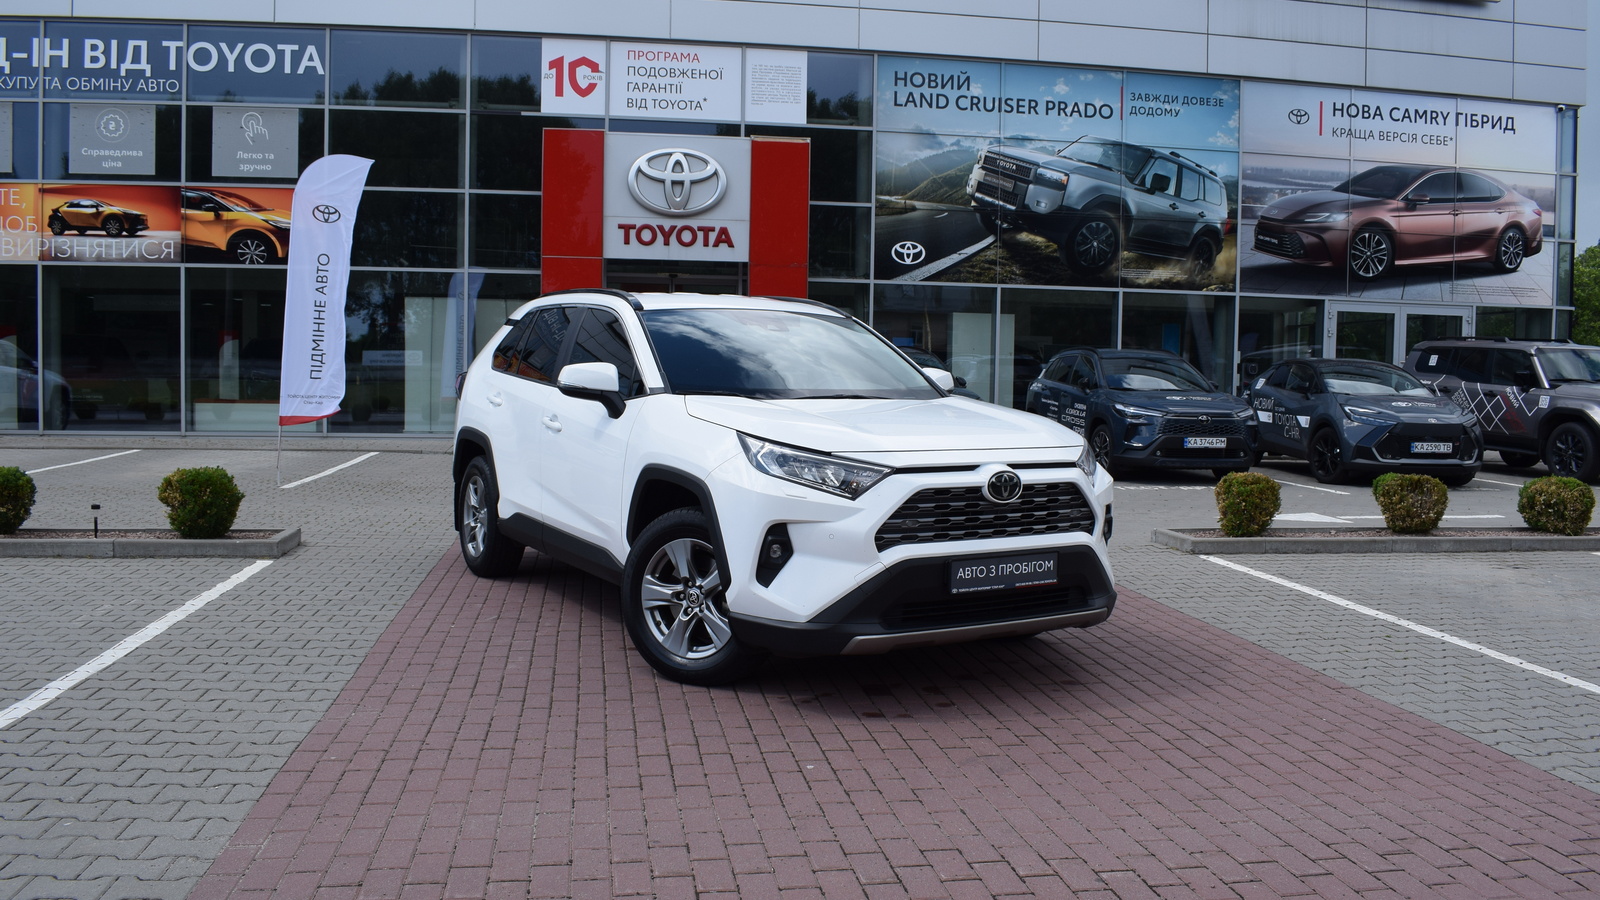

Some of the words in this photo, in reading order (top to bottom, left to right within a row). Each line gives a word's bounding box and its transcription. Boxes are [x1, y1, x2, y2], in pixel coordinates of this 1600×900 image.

[84, 38, 151, 77] ВІД
[162, 40, 325, 75] TOYOTA
[627, 50, 700, 63] ПРОГРАМА
[548, 56, 600, 98] 10
[627, 66, 724, 80] ПОДОВЖЕНОЇ
[894, 70, 971, 92] НОВИЙ
[44, 76, 61, 90] ТА
[67, 77, 133, 92] ОБМІНУ
[136, 79, 180, 93] АВТО
[626, 81, 684, 94] ГАРАНТІЇ
[627, 98, 648, 110] ВІД
[893, 91, 950, 110] LAND
[954, 93, 1040, 116] CRUISER
[1045, 101, 1114, 120] PRADO
[1129, 92, 1179, 105] ЗАВЖДИ
[1181, 95, 1225, 108] ДОВЕЗЕ
[1129, 106, 1181, 118] ДОДОМУ
[1332, 102, 1384, 121] НОВА
[1389, 106, 1450, 126] CAMRY
[1455, 112, 1516, 135] ГІБРИД
[1332, 127, 1375, 142] КРАЩА
[1378, 131, 1418, 144] ВЕРСІЯ
[82, 147, 143, 158] Справедлива
[236, 151, 262, 160] Легко
[102, 160, 122, 169] ціна
[239, 163, 272, 172] зручно
[0, 215, 38, 236] ОБ
[618, 223, 735, 248] TOYOTA
[2, 237, 174, 259] ВИРІЗНЯТИСЯ
[315, 253, 331, 296] АВТО
[310, 299, 327, 380] ПІДМІННЕ
[1061, 415, 1086, 426] CROSS
[1274, 412, 1297, 426] TOYOTA
[1199, 438, 1215, 446] 3746
[957, 566, 987, 580] АВТО
[989, 565, 996, 577] З
[998, 560, 1054, 576] ПРОБІГОМ
